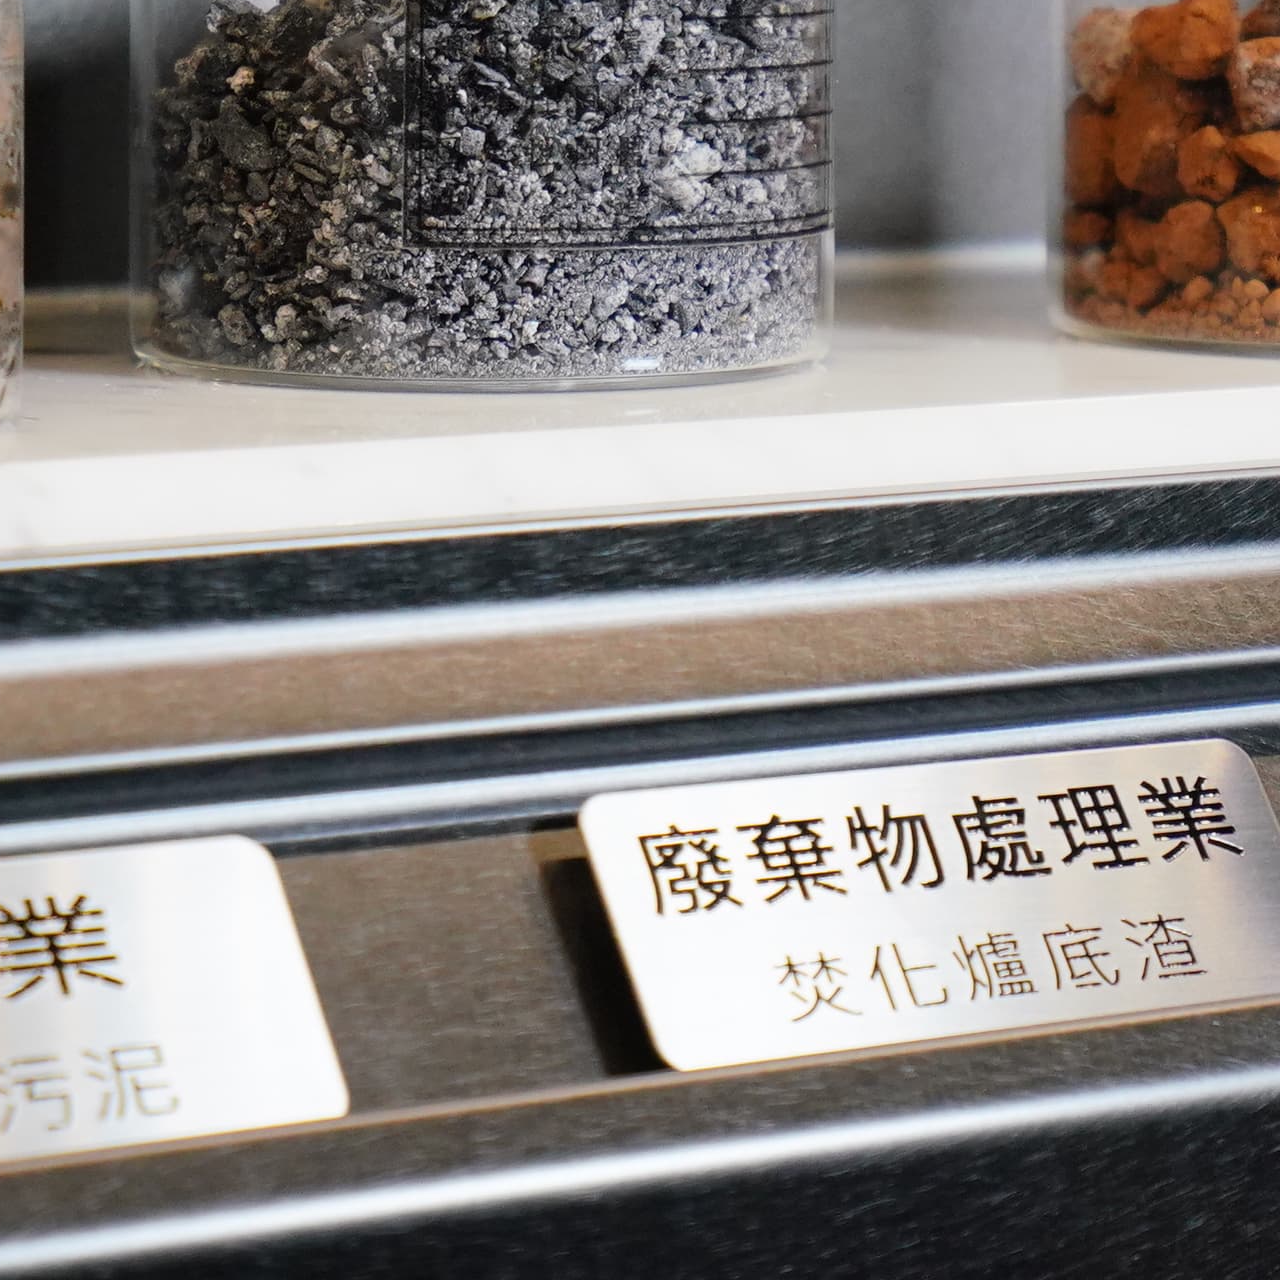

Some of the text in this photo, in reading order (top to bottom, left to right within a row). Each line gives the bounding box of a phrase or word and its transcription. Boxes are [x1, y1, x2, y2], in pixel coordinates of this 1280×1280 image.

[635, 775, 1247, 916] 廢棄物處理業
[774, 914, 1208, 1023] 焚化爐底渣
